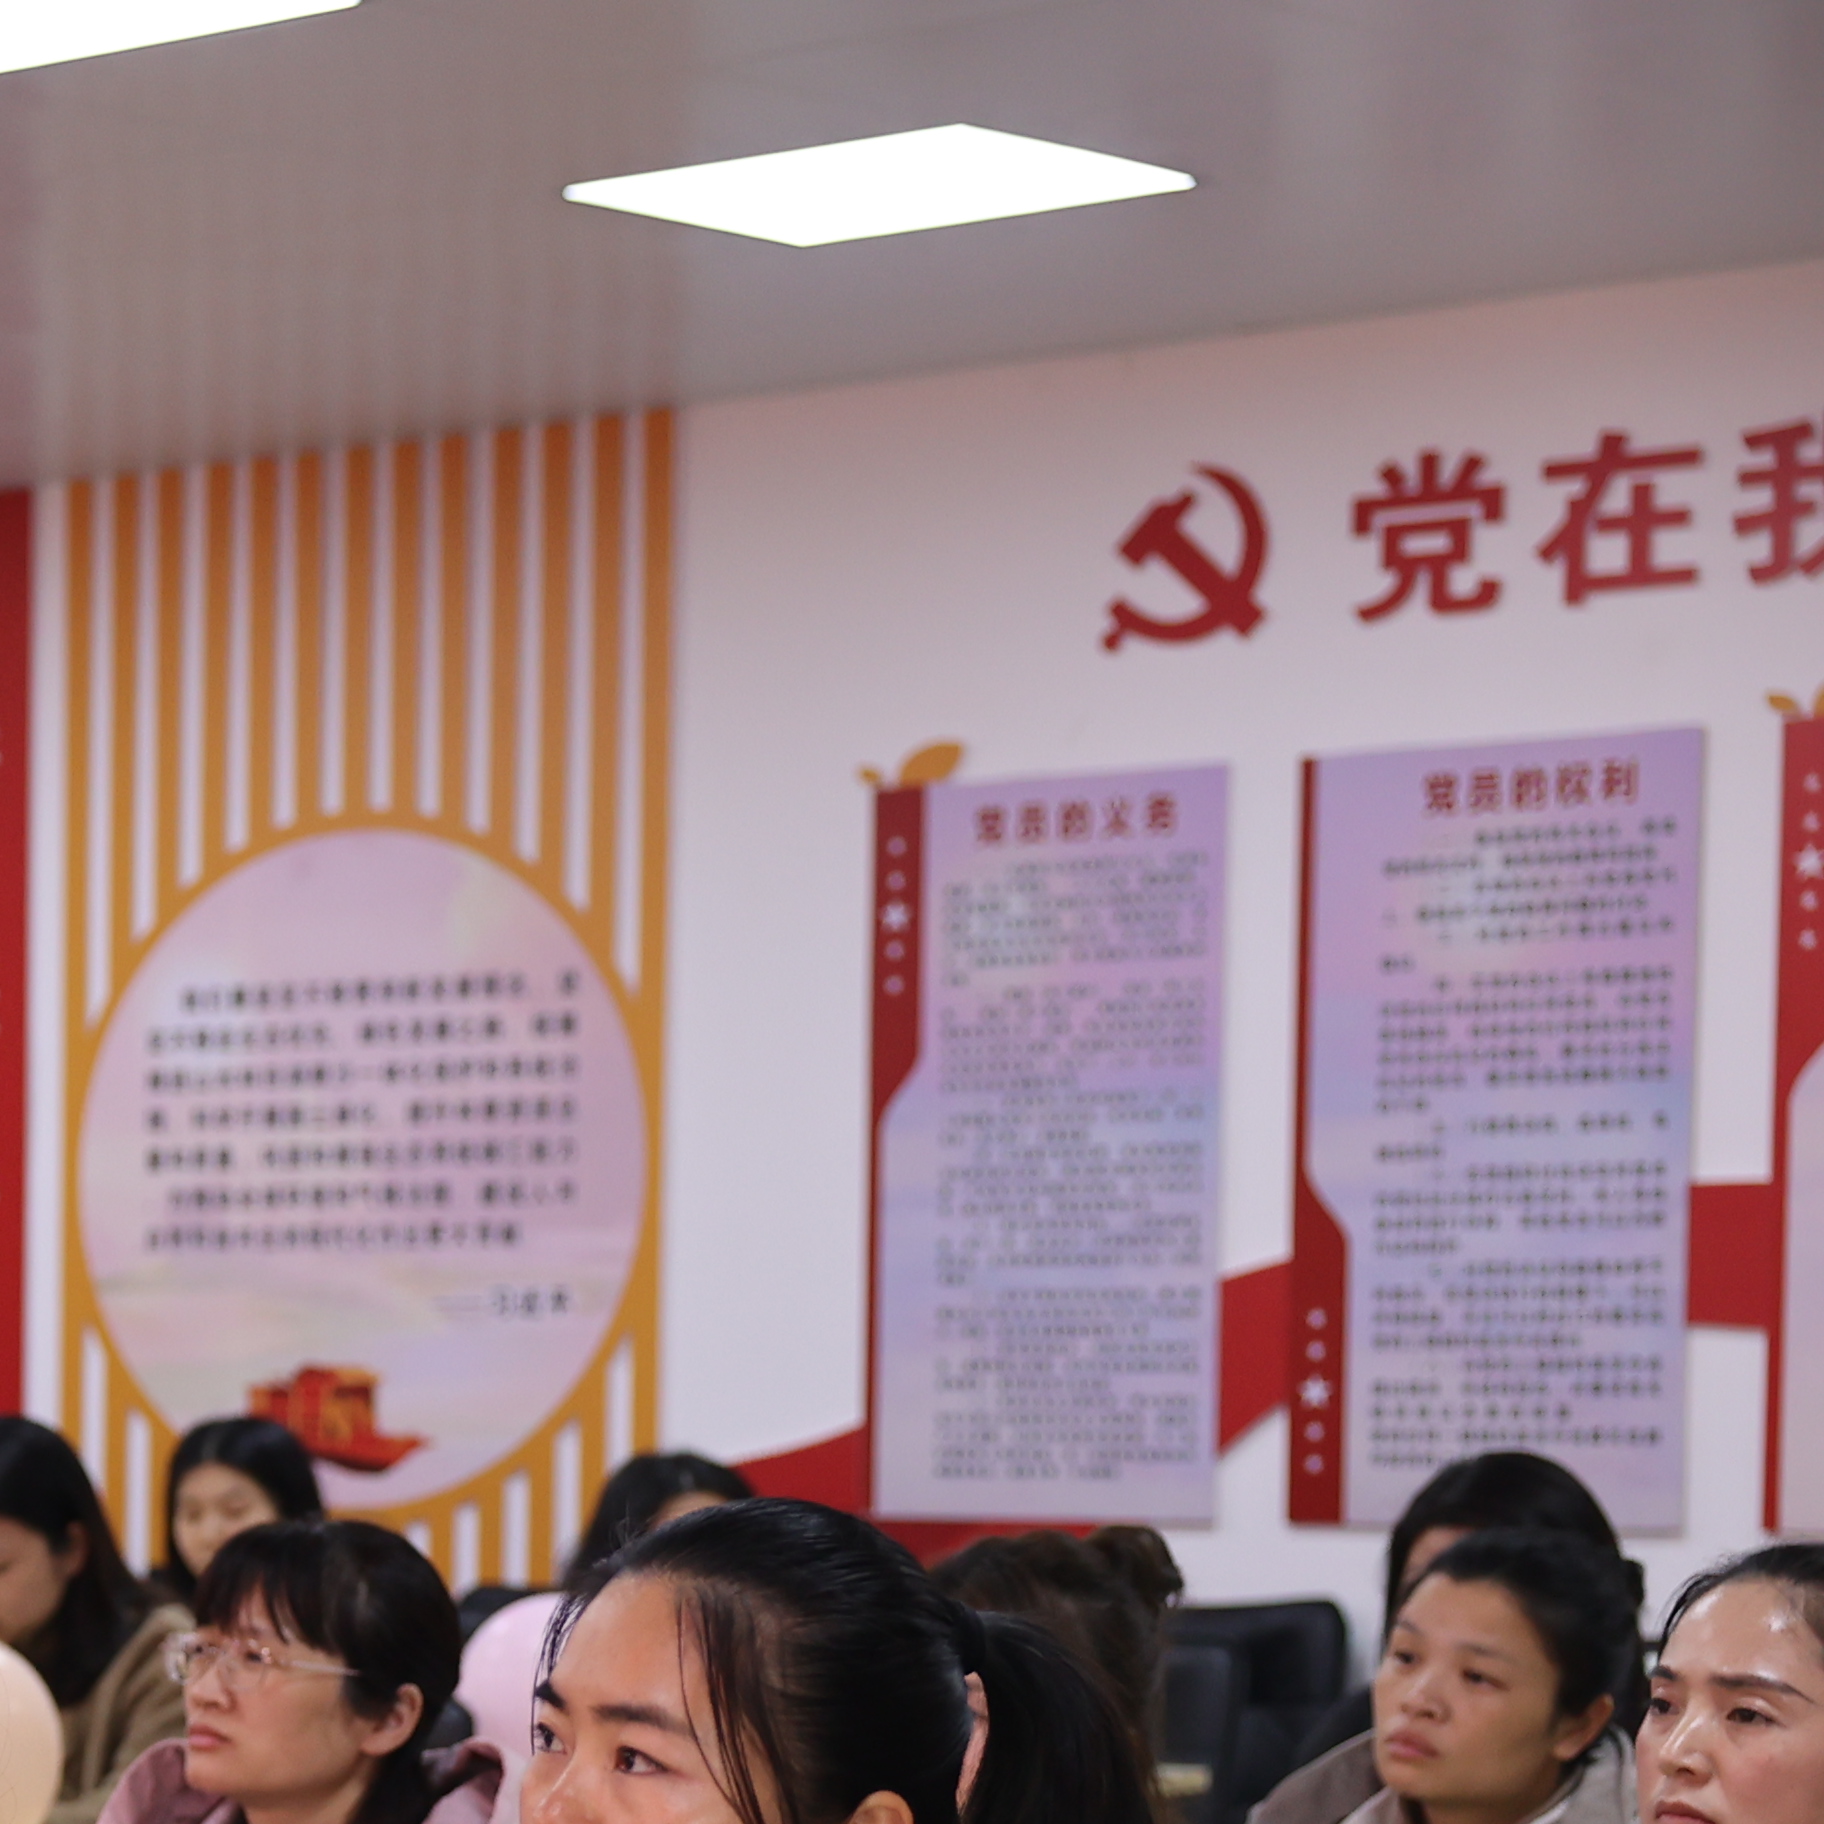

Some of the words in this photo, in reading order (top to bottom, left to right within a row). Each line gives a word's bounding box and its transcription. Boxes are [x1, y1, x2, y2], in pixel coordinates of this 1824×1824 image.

[1423, 758, 1641, 815] 党员的权利
